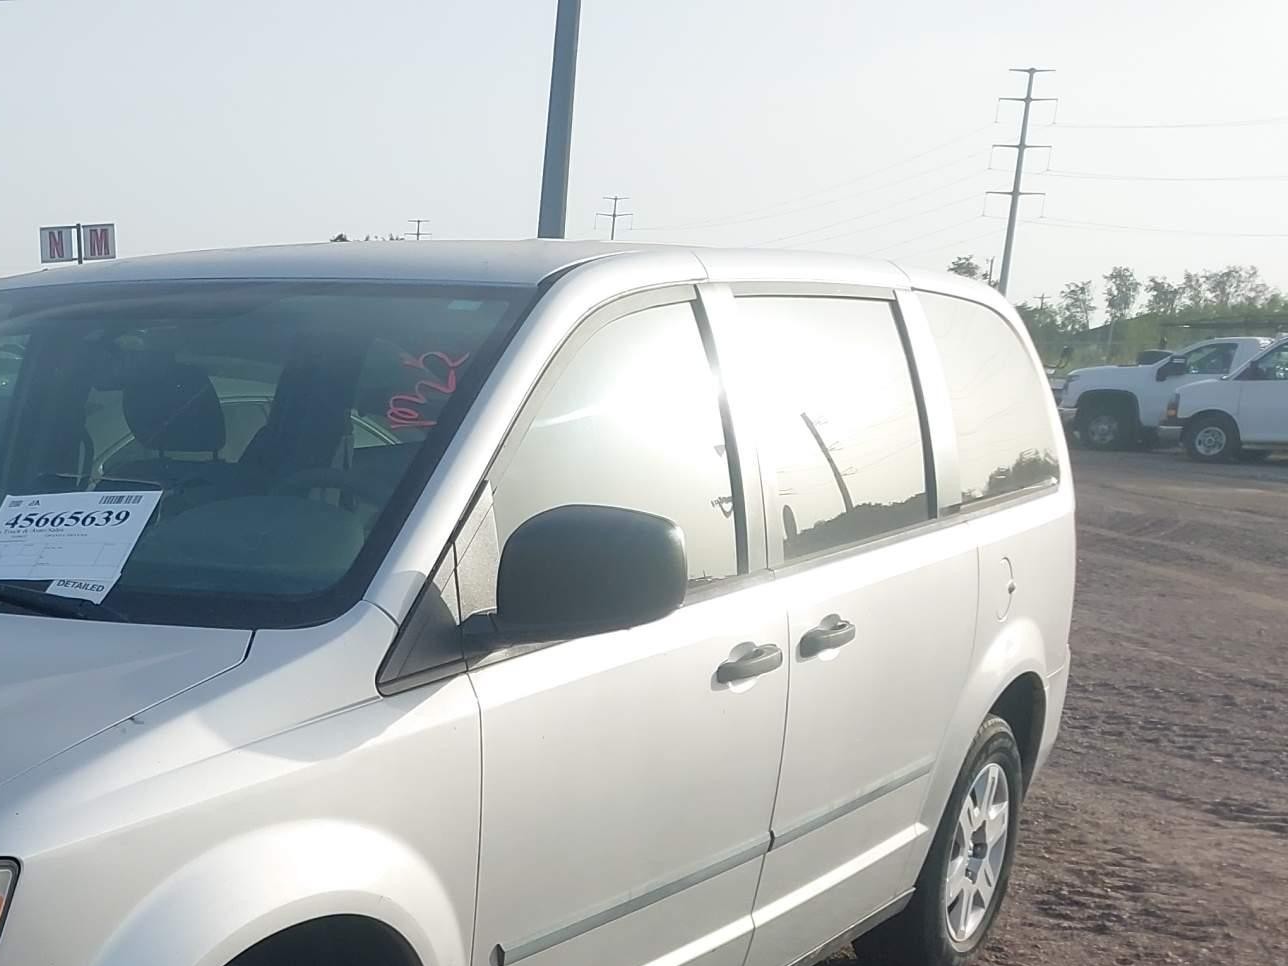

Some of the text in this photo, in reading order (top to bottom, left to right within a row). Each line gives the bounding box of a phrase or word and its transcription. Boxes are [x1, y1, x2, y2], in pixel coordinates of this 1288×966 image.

[49, 229, 110, 258] N M
[5, 510, 131, 529] 45665639
[57, 579, 105, 592] DETAILED
